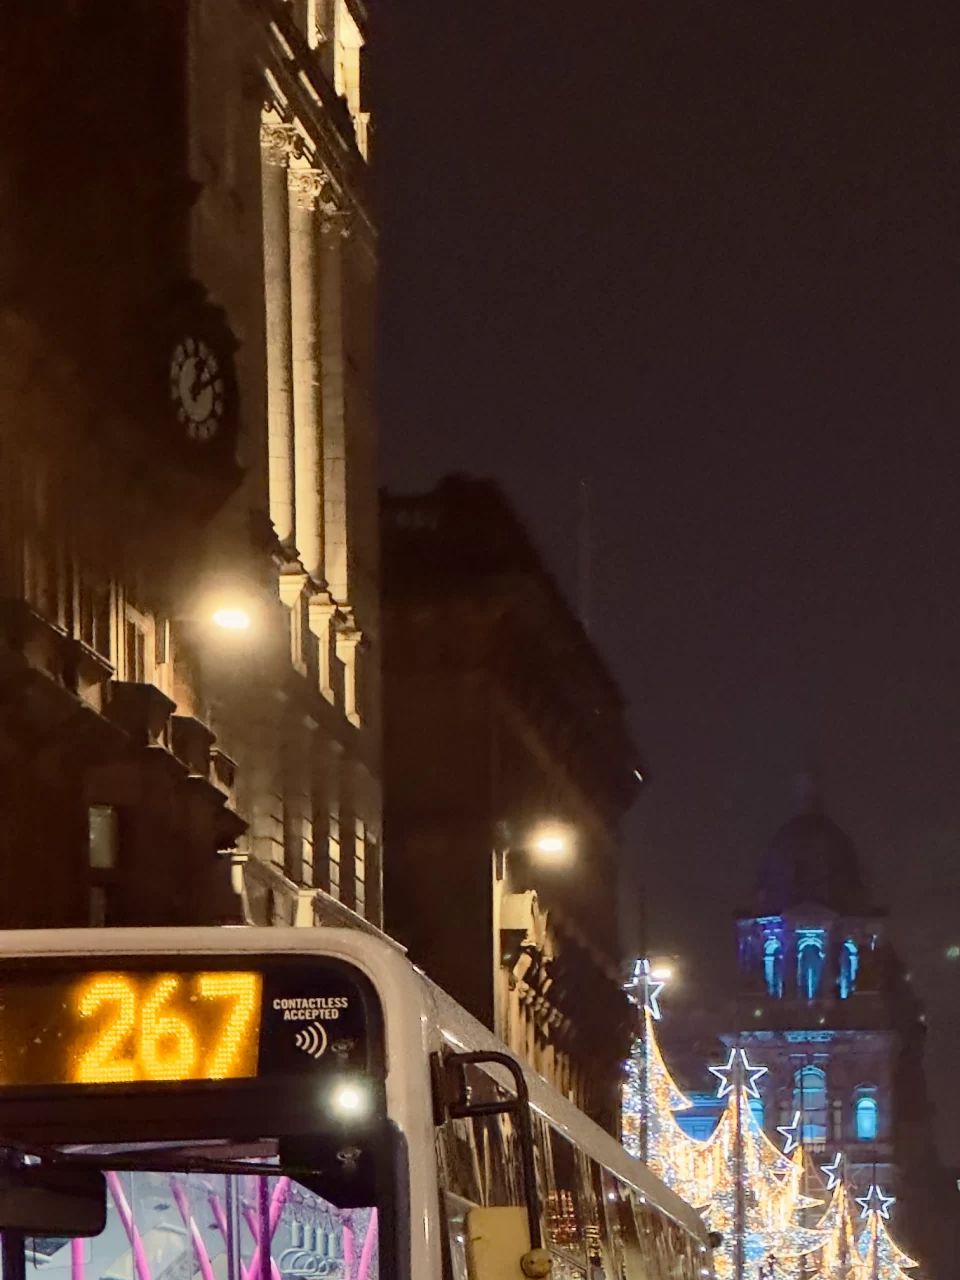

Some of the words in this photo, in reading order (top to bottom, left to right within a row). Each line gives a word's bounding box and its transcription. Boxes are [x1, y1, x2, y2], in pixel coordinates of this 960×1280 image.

[273, 997, 348, 1009] CONTACTLESS
[284, 1008, 339, 1020] ACCEPTED
[78, 973, 259, 1083] 267
